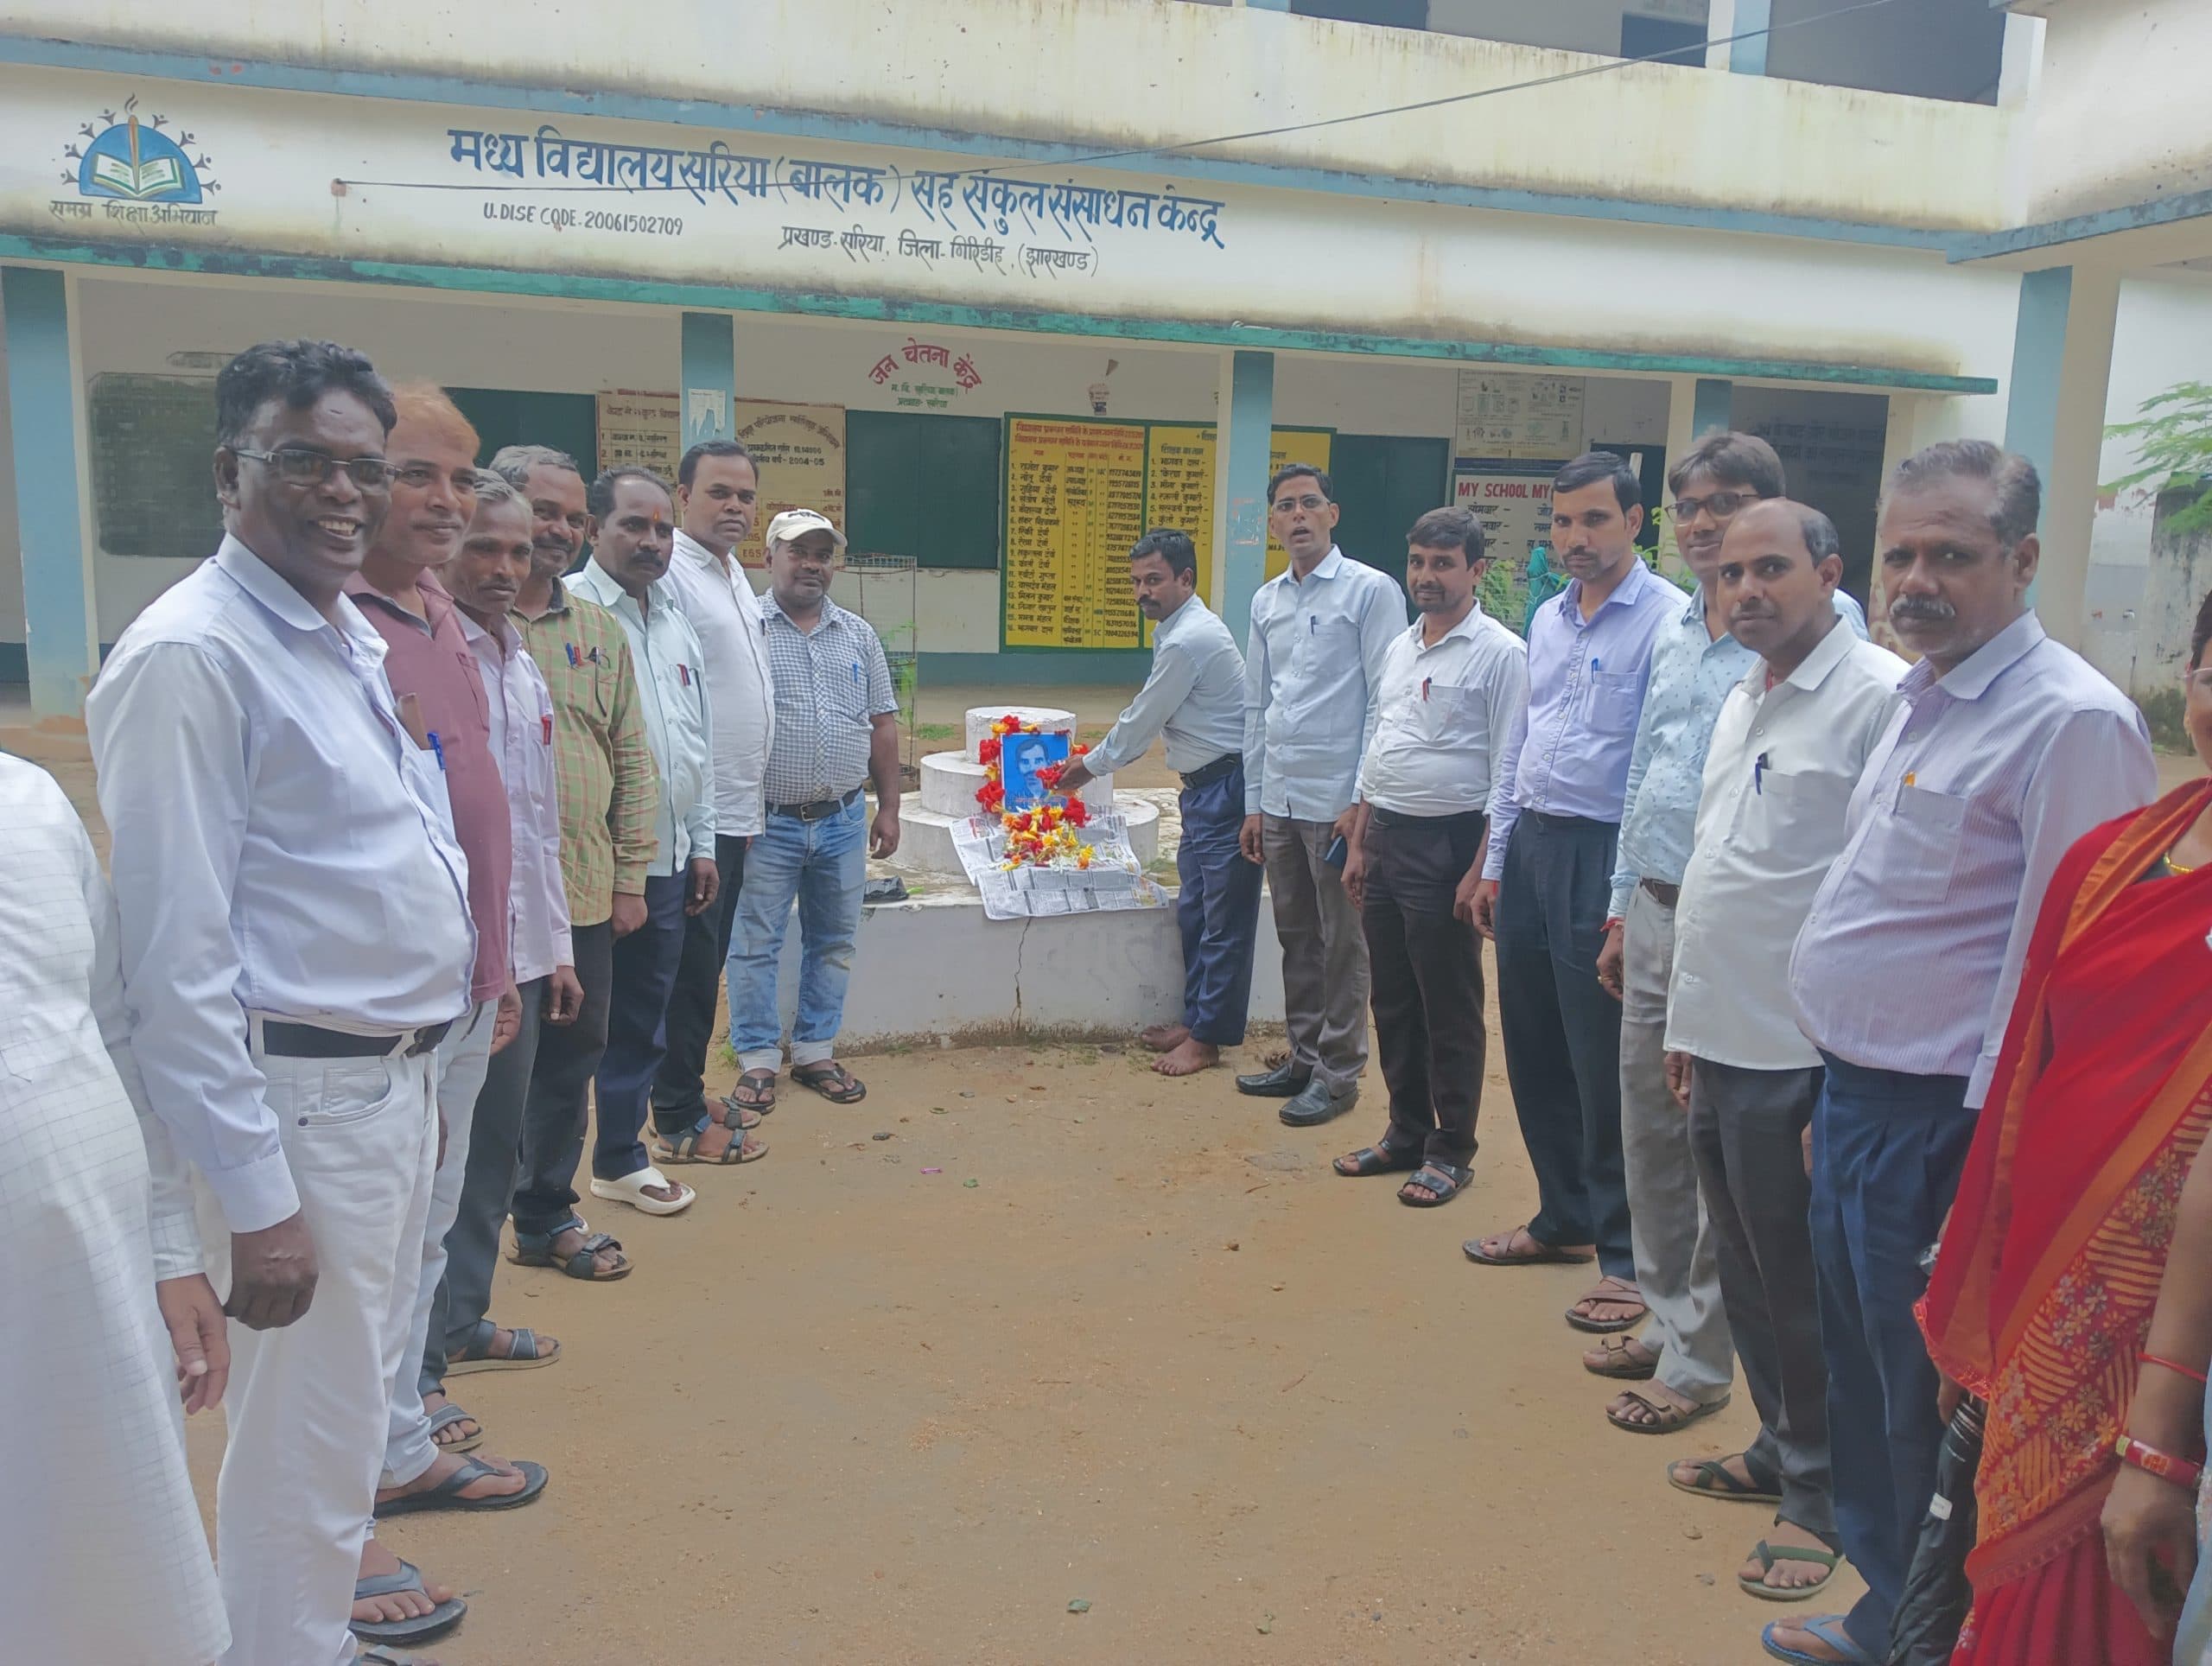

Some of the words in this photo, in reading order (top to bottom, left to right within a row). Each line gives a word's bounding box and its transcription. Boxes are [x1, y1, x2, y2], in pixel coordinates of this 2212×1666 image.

[447, 129, 529, 178] मध्य
[534, 124, 684, 194] विद्यालय
[679, 140, 771, 206] सरिया
[911, 170, 960, 232] सह
[963, 169, 1051, 236] संकुल
[1048, 178, 1160, 243] संसाधन
[1158, 183, 1225, 250] केन्द्र
[49, 200, 93, 222] समग्र
[101, 200, 149, 236] शिक्षा
[151, 203, 218, 227] अभियान
[868, 353, 899, 385] जन
[901, 337, 950, 369] चेतना
[1459, 482, 1479, 498] MY
[1484, 483, 1529, 499] SCHOOL
[1532, 484, 1551, 499] MY
